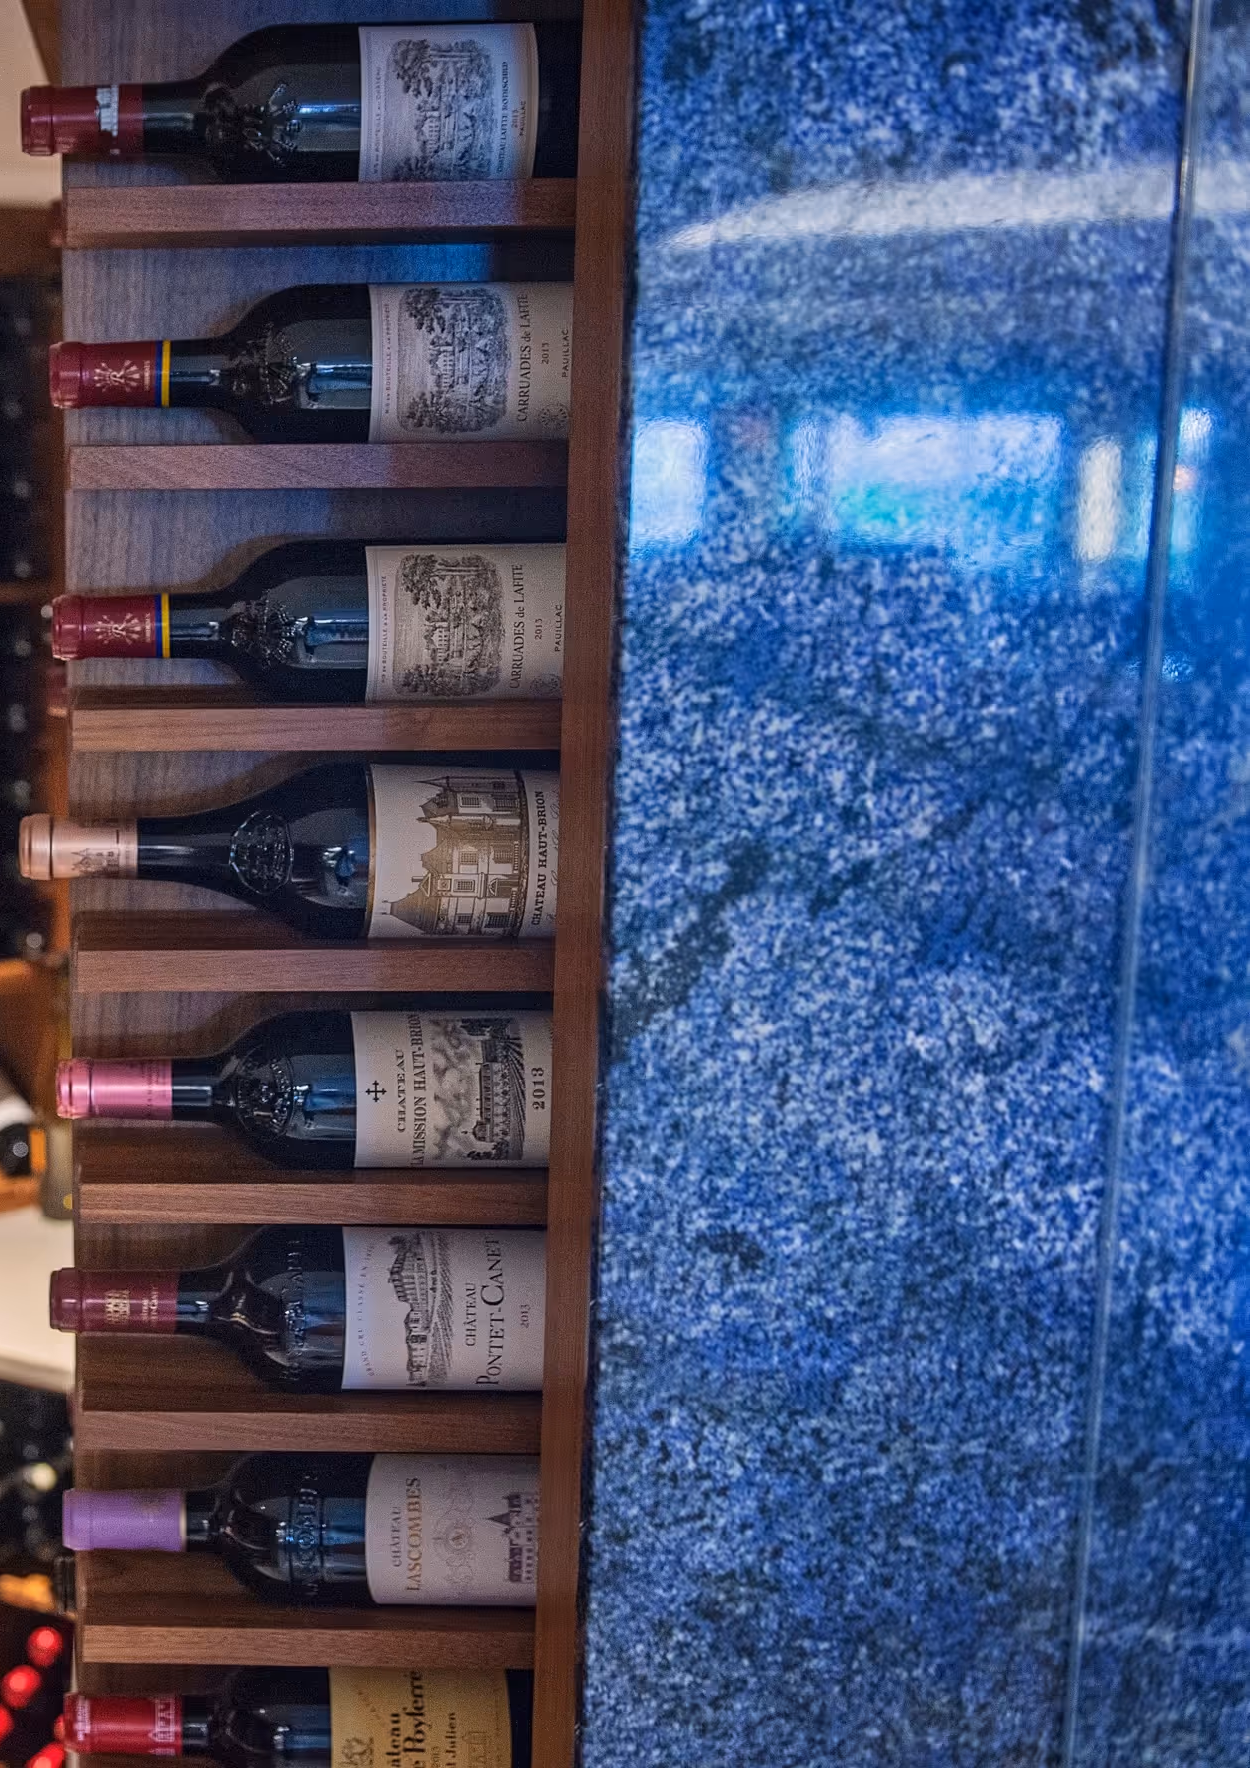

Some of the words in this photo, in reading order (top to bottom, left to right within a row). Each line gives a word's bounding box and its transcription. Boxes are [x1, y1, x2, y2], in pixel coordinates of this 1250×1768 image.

[516, 294, 531, 328] LAFITE
[520, 331, 531, 342] de
[561, 328, 570, 378] PAUILLAC
[516, 345, 532, 422] CARRUADES
[511, 564, 525, 603] LAFITE
[514, 606, 524, 618] de
[554, 604, 562, 652] PAUILLAC
[509, 621, 524, 688] CARRUADES
[534, 791, 548, 868] HAUT-BRION
[531, 873, 546, 926] CHATEAU
[407, 1013, 426, 1091] HAUT-BRION
[396, 1048, 406, 1133] CHATEAU
[531, 1067, 546, 1110] 2013
[412, 1096, 426, 1154] MISSION
[410, 1156, 424, 1166] LA
[360, 1266, 368, 1278] EN
[463, 1282, 476, 1346] CHÂTEAU
[475, 1236, 505, 1385] PONTET-CANET
[520, 1304, 530, 1328] 2013
[357, 1327, 365, 1346] CRU
[361, 1351, 375, 1376] GRAND
[390, 1506, 402, 1567] CHÂTEAU
[405, 1477, 422, 1591] LASCOMBES
[445, 1712, 457, 1758] Julien
